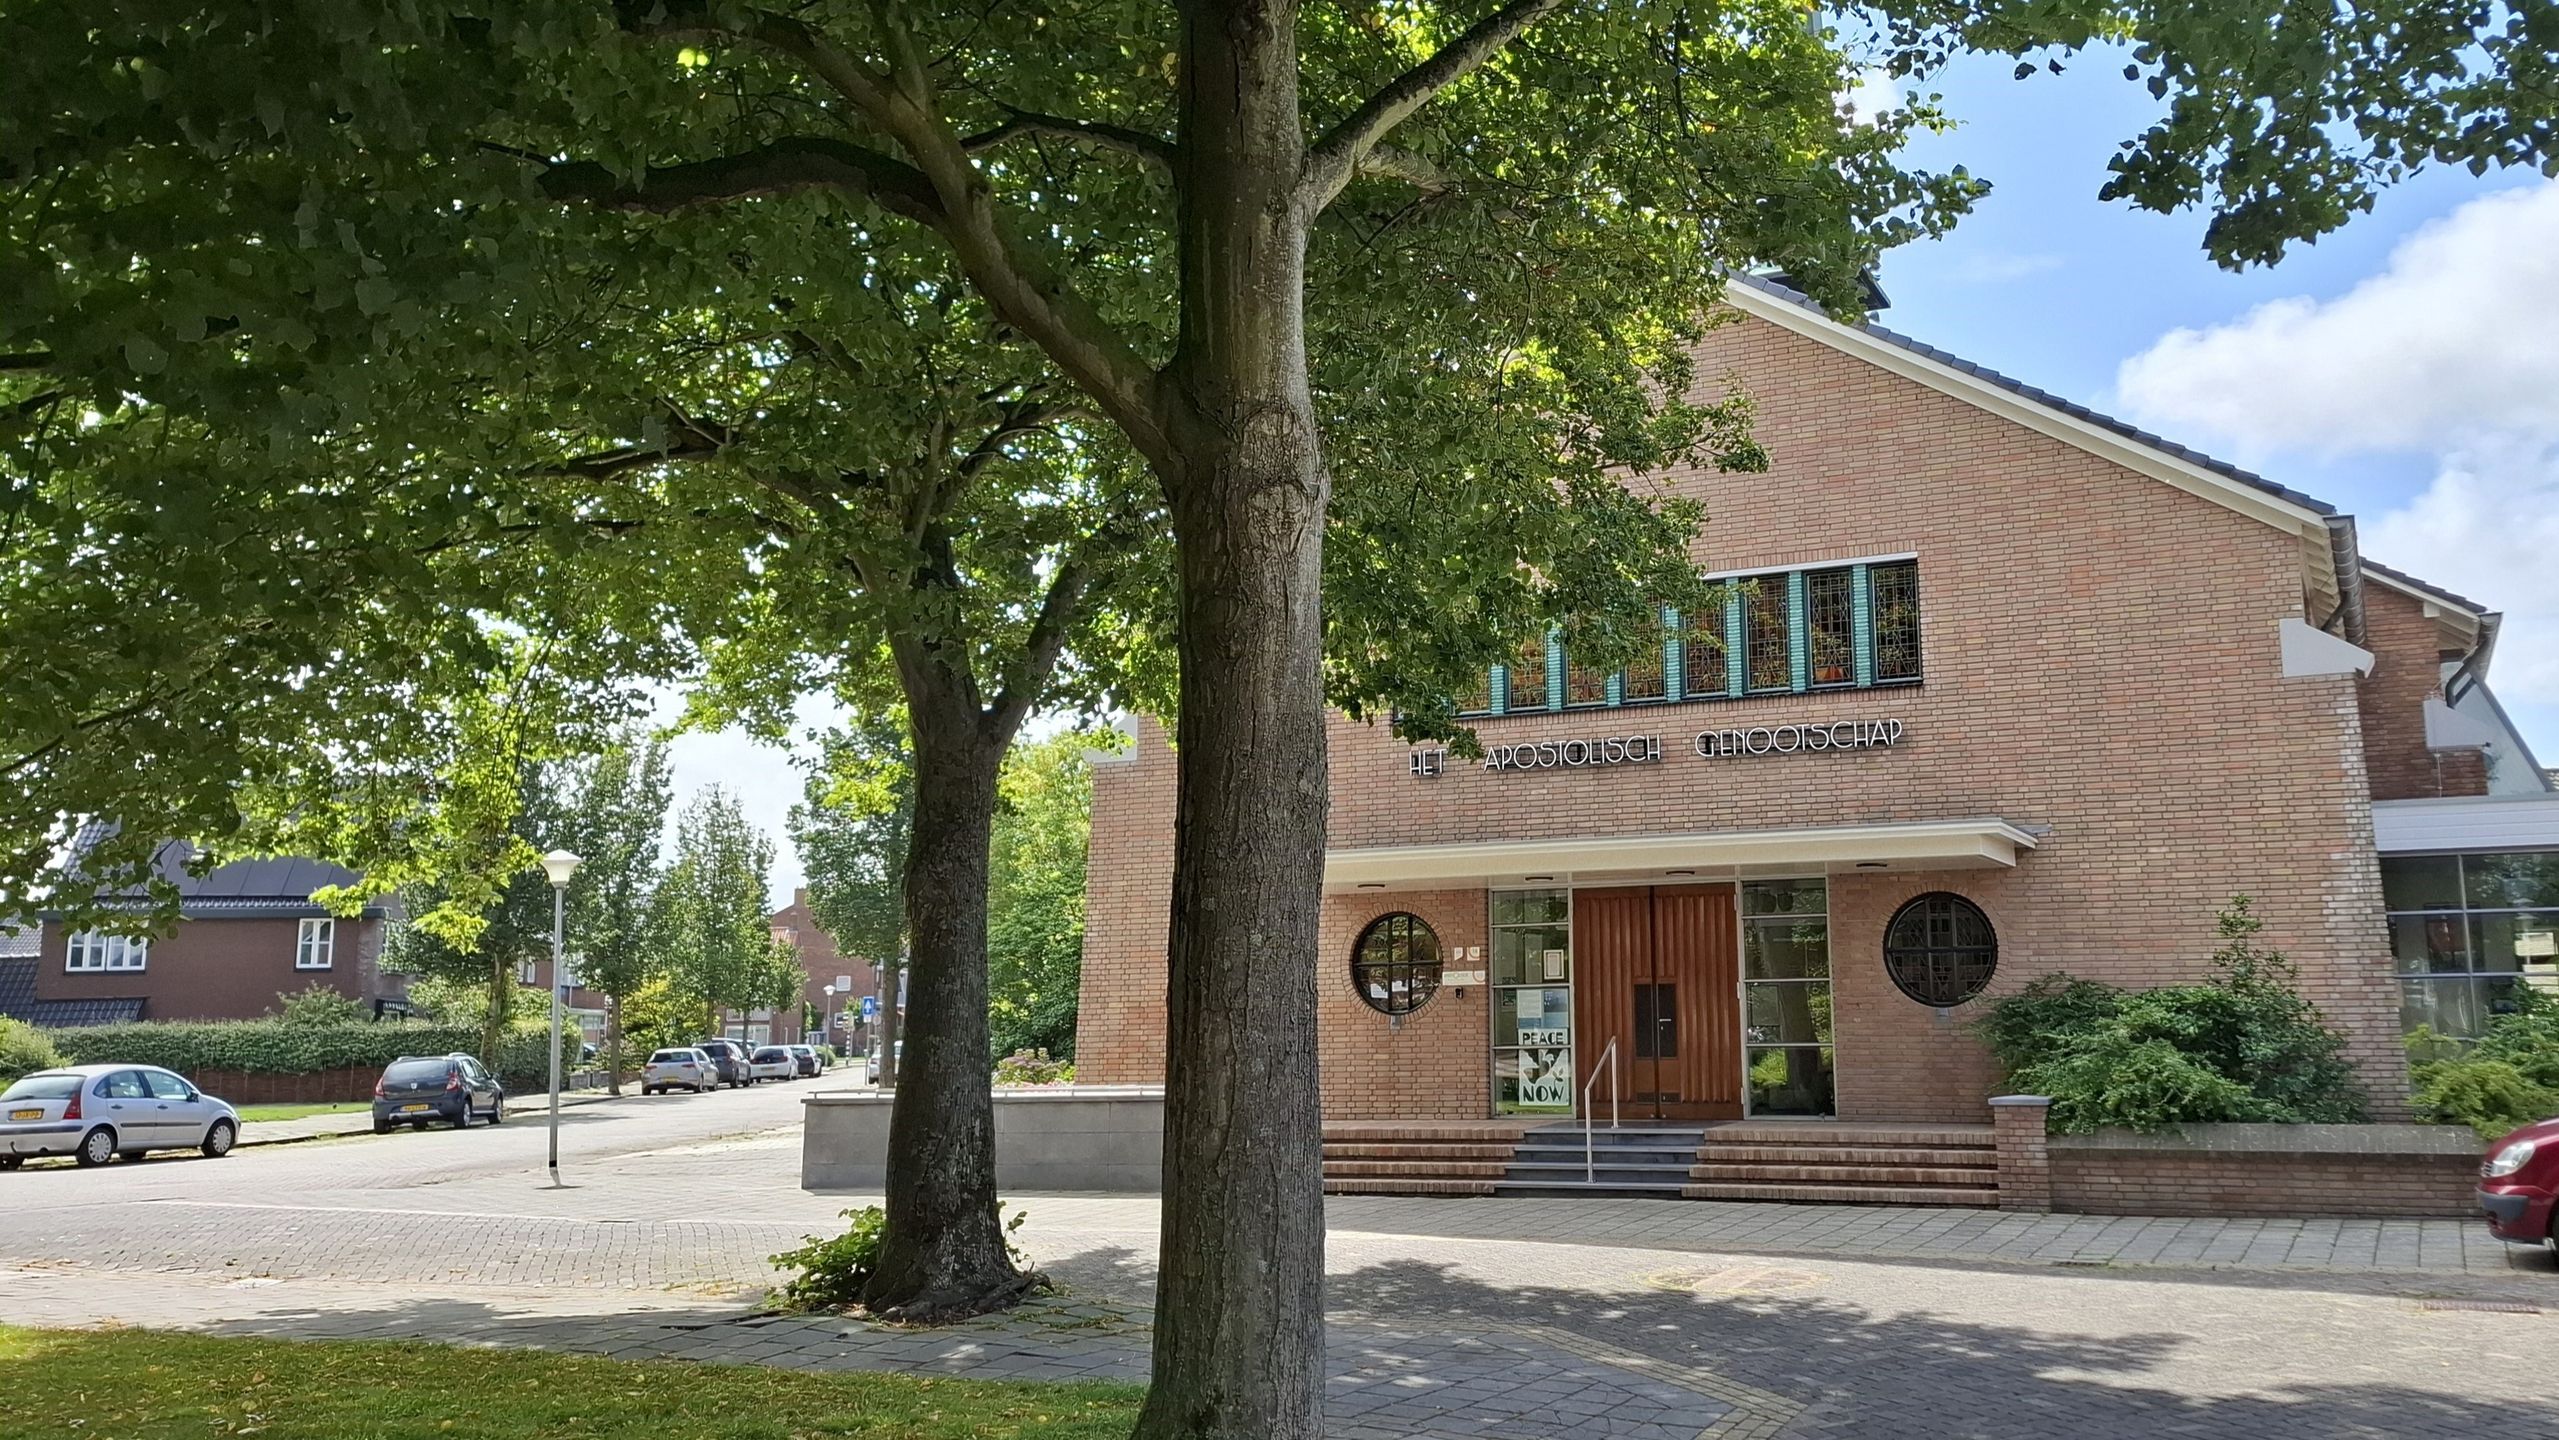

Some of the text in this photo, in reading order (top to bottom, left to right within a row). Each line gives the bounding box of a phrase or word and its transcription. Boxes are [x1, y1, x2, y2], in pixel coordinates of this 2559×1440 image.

[1409, 719, 1903, 776] HET APOSTOLISCH GENOOTSCHAP
[1523, 1032, 1563, 1044] PEACE
[1523, 1085, 1564, 1102] NOW
